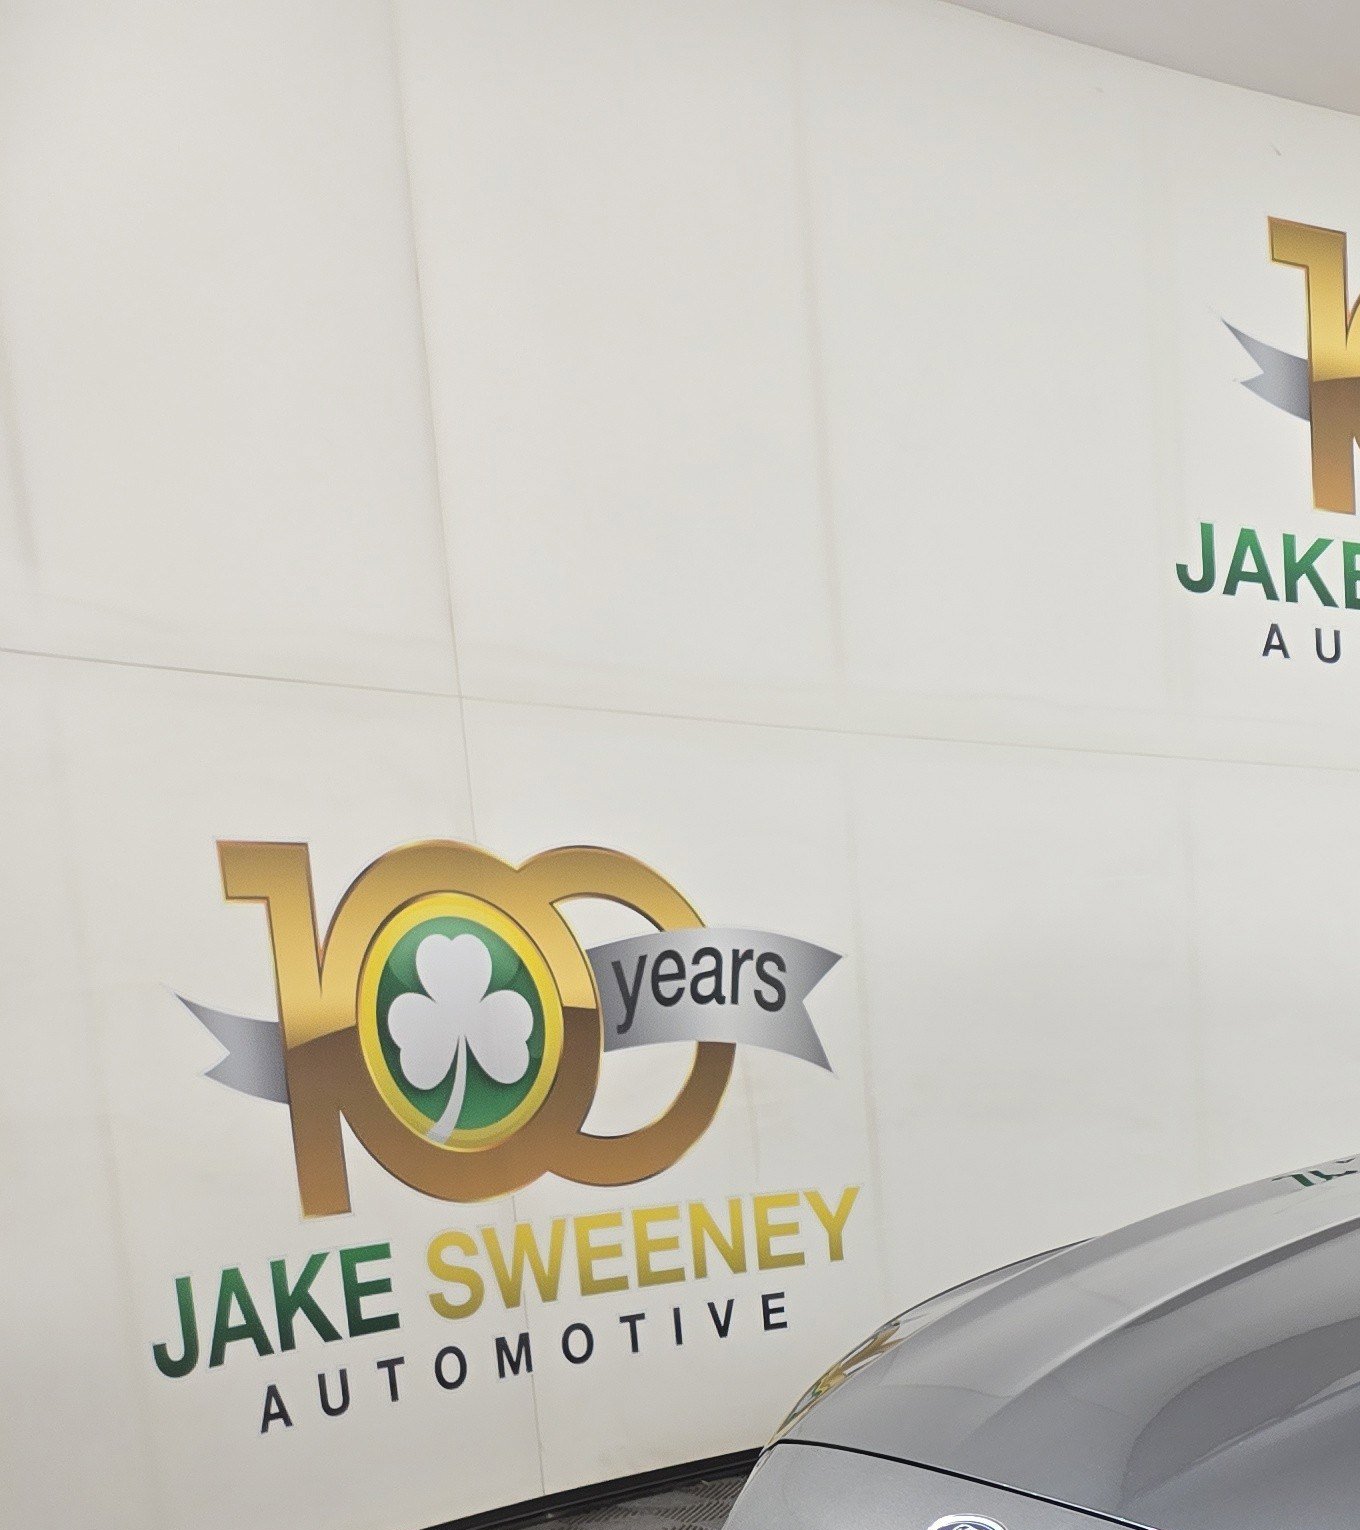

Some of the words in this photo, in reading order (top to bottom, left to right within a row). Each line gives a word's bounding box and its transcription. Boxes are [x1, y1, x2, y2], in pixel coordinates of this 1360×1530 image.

[217, 839, 738, 1219] 100
[610, 947, 788, 1035] years
[152, 1242, 402, 1379] JAKE
[425, 1186, 860, 1320] SWEENEY
[260, 1291, 789, 1434] AUTOMOTIVE
